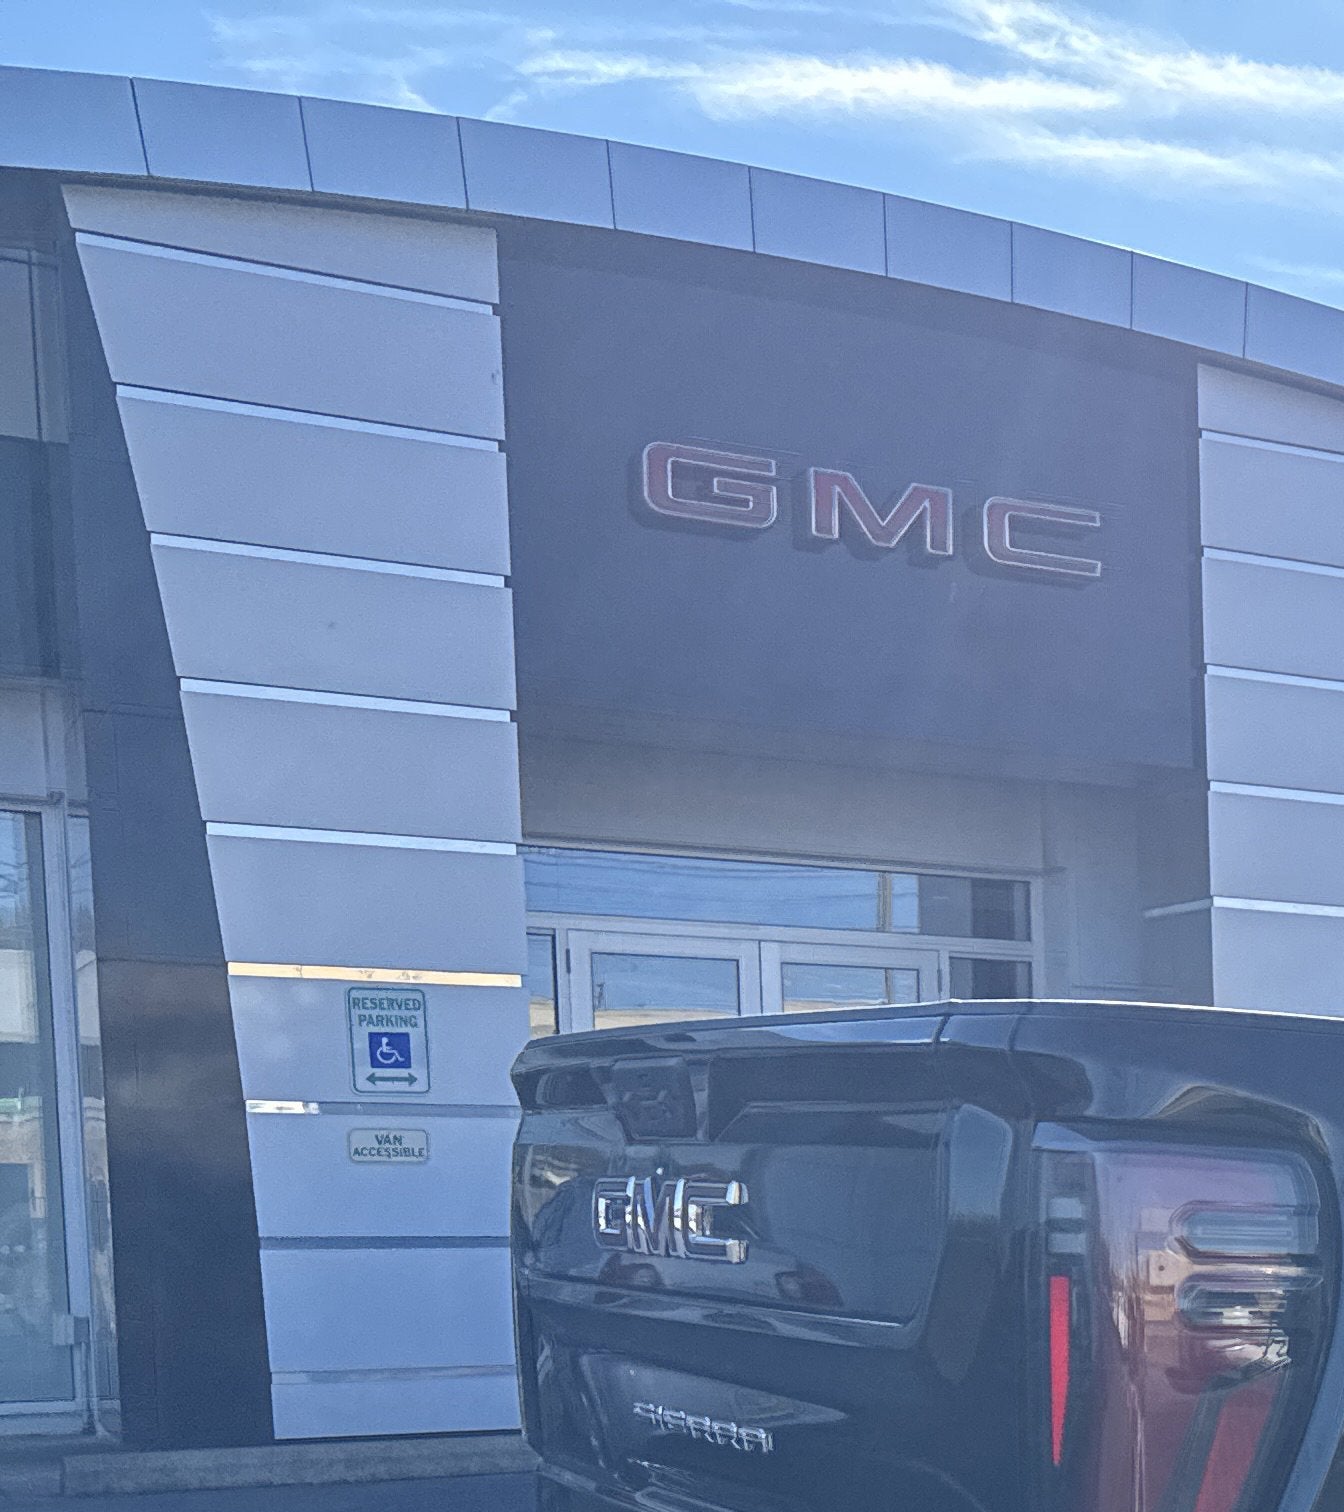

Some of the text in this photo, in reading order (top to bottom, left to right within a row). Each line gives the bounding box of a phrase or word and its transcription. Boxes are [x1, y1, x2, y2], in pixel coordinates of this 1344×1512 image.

[642, 440, 1102, 577] GMC
[351, 996, 422, 1011] RESERVED
[357, 1013, 419, 1029] PARKING
[374, 1134, 403, 1146] VAN
[352, 1146, 425, 1159] ACCESSIBLE
[591, 1175, 749, 1264] GMC
[633, 1402, 774, 1454] SIERRA
